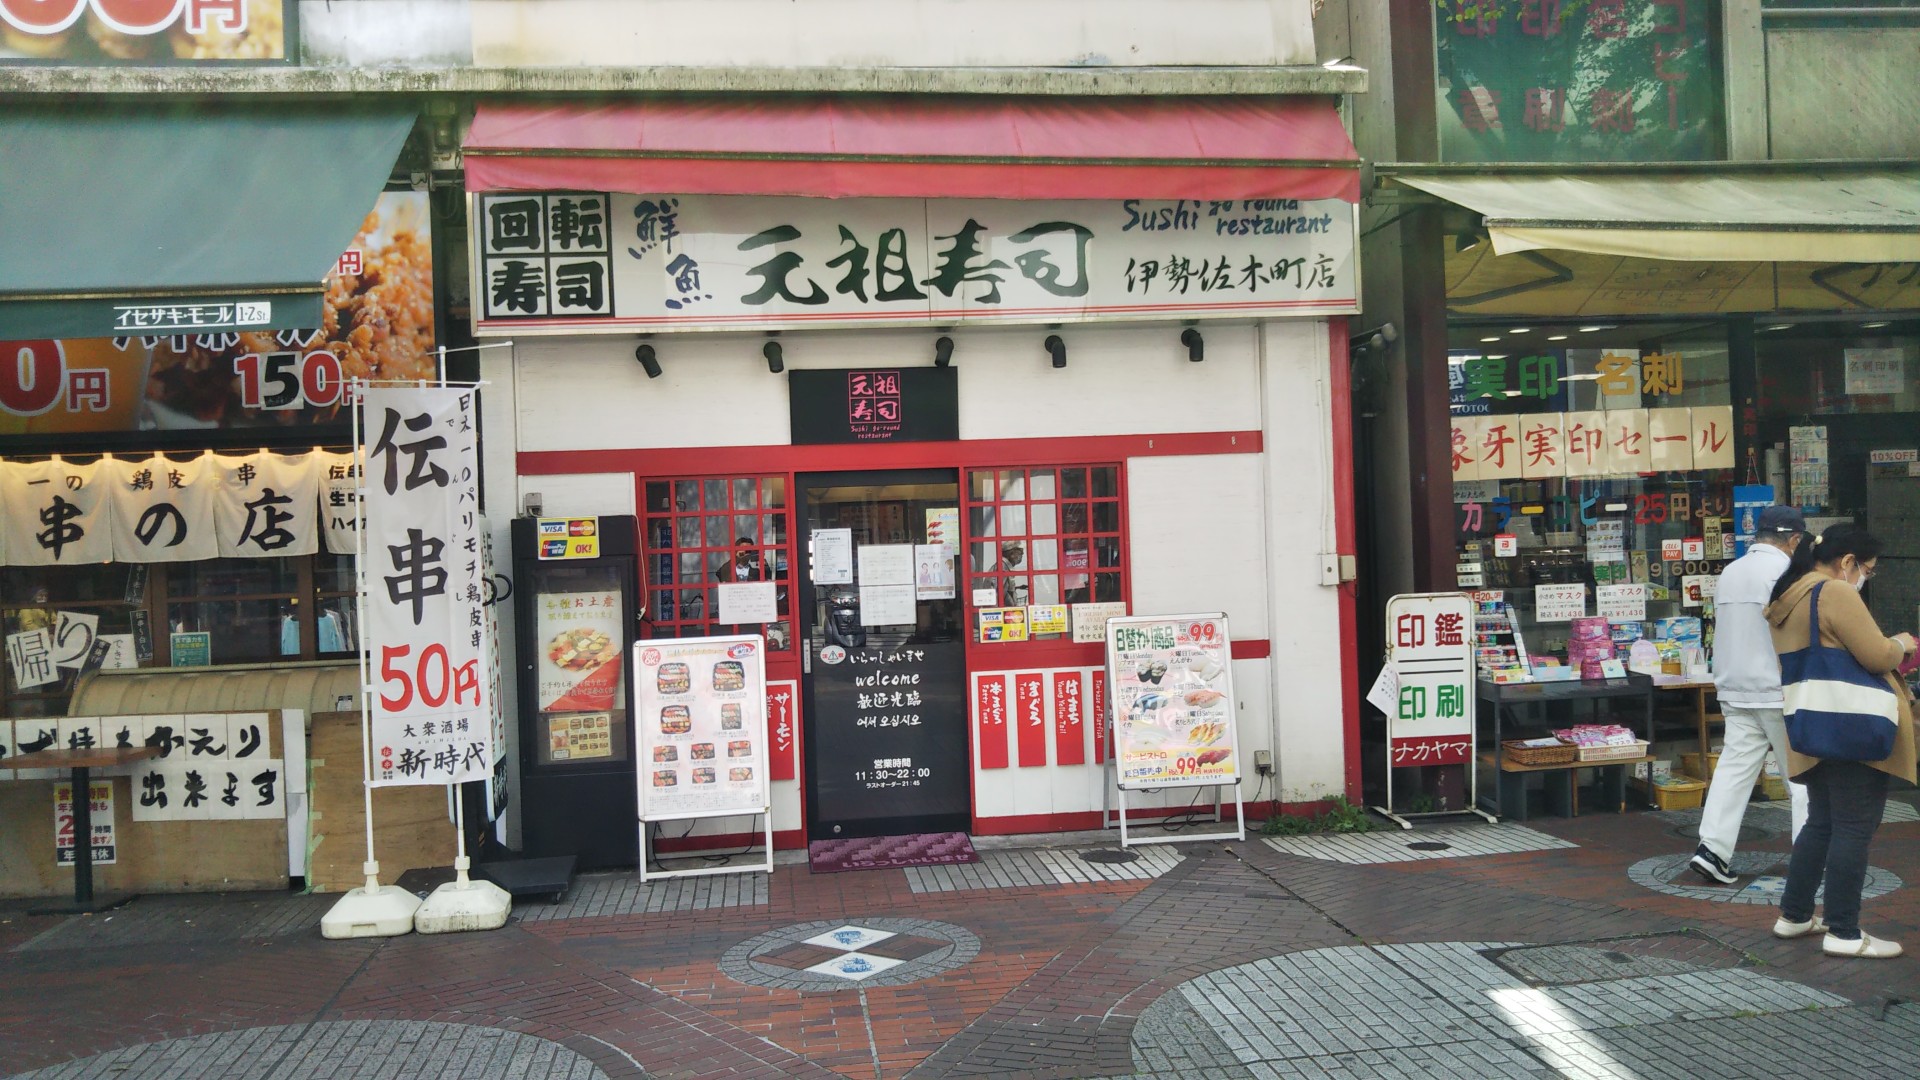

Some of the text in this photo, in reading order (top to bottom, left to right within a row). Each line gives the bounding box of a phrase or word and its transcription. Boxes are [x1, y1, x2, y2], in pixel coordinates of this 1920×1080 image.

[490, 198, 604, 253] 回転
[1122, 200, 1200, 231] Sushi
[1216, 213, 1332, 236] restaurant
[628, 198, 713, 310] 鮮魚
[737, 217, 1095, 304] 元祖寿司
[492, 260, 604, 314] 寿司
[1124, 253, 1335, 296] 伊勢佐木町店
[116, 306, 234, 327] イセサキ・モール
[850, 374, 900, 396] 元祖
[1464, 355, 1558, 401] 実印
[1595, 352, 1684, 396] 名刺
[850, 399, 898, 421] 寿司
[331, 516, 367, 532] ハイ
[370, 407, 450, 626] 伝串
[544, 525, 563, 533] VISA
[575, 544, 592, 554] OK!
[1556, 591, 1582, 600] マスク
[1618, 587, 1643, 596] マスク
[1009, 630, 1021, 638] OK!
[1116, 625, 1176, 652] 日替わり商品
[1397, 612, 1464, 649] 印鑑
[850, 650, 925, 664] いらっしゃいませ
[379, 642, 482, 713] 50円
[855, 670, 921, 687] welcome
[1019, 682, 1027, 700] Tuna
[1028, 681, 1042, 726] まぐろ
[1065, 679, 1080, 725] はまち
[1398, 684, 1465, 720] 印刷
[402, 717, 469, 738] 大衆酒場
[774, 692, 791, 752] サーモン
[856, 714, 922, 728] 어서 오십시오
[396, 741, 486, 780] 新時代
[873, 757, 911, 769] 営業時間
[1395, 740, 1468, 763] ナカヤマ
[1176, 757, 1196, 775] 99
[139, 767, 277, 810] 出来ます
